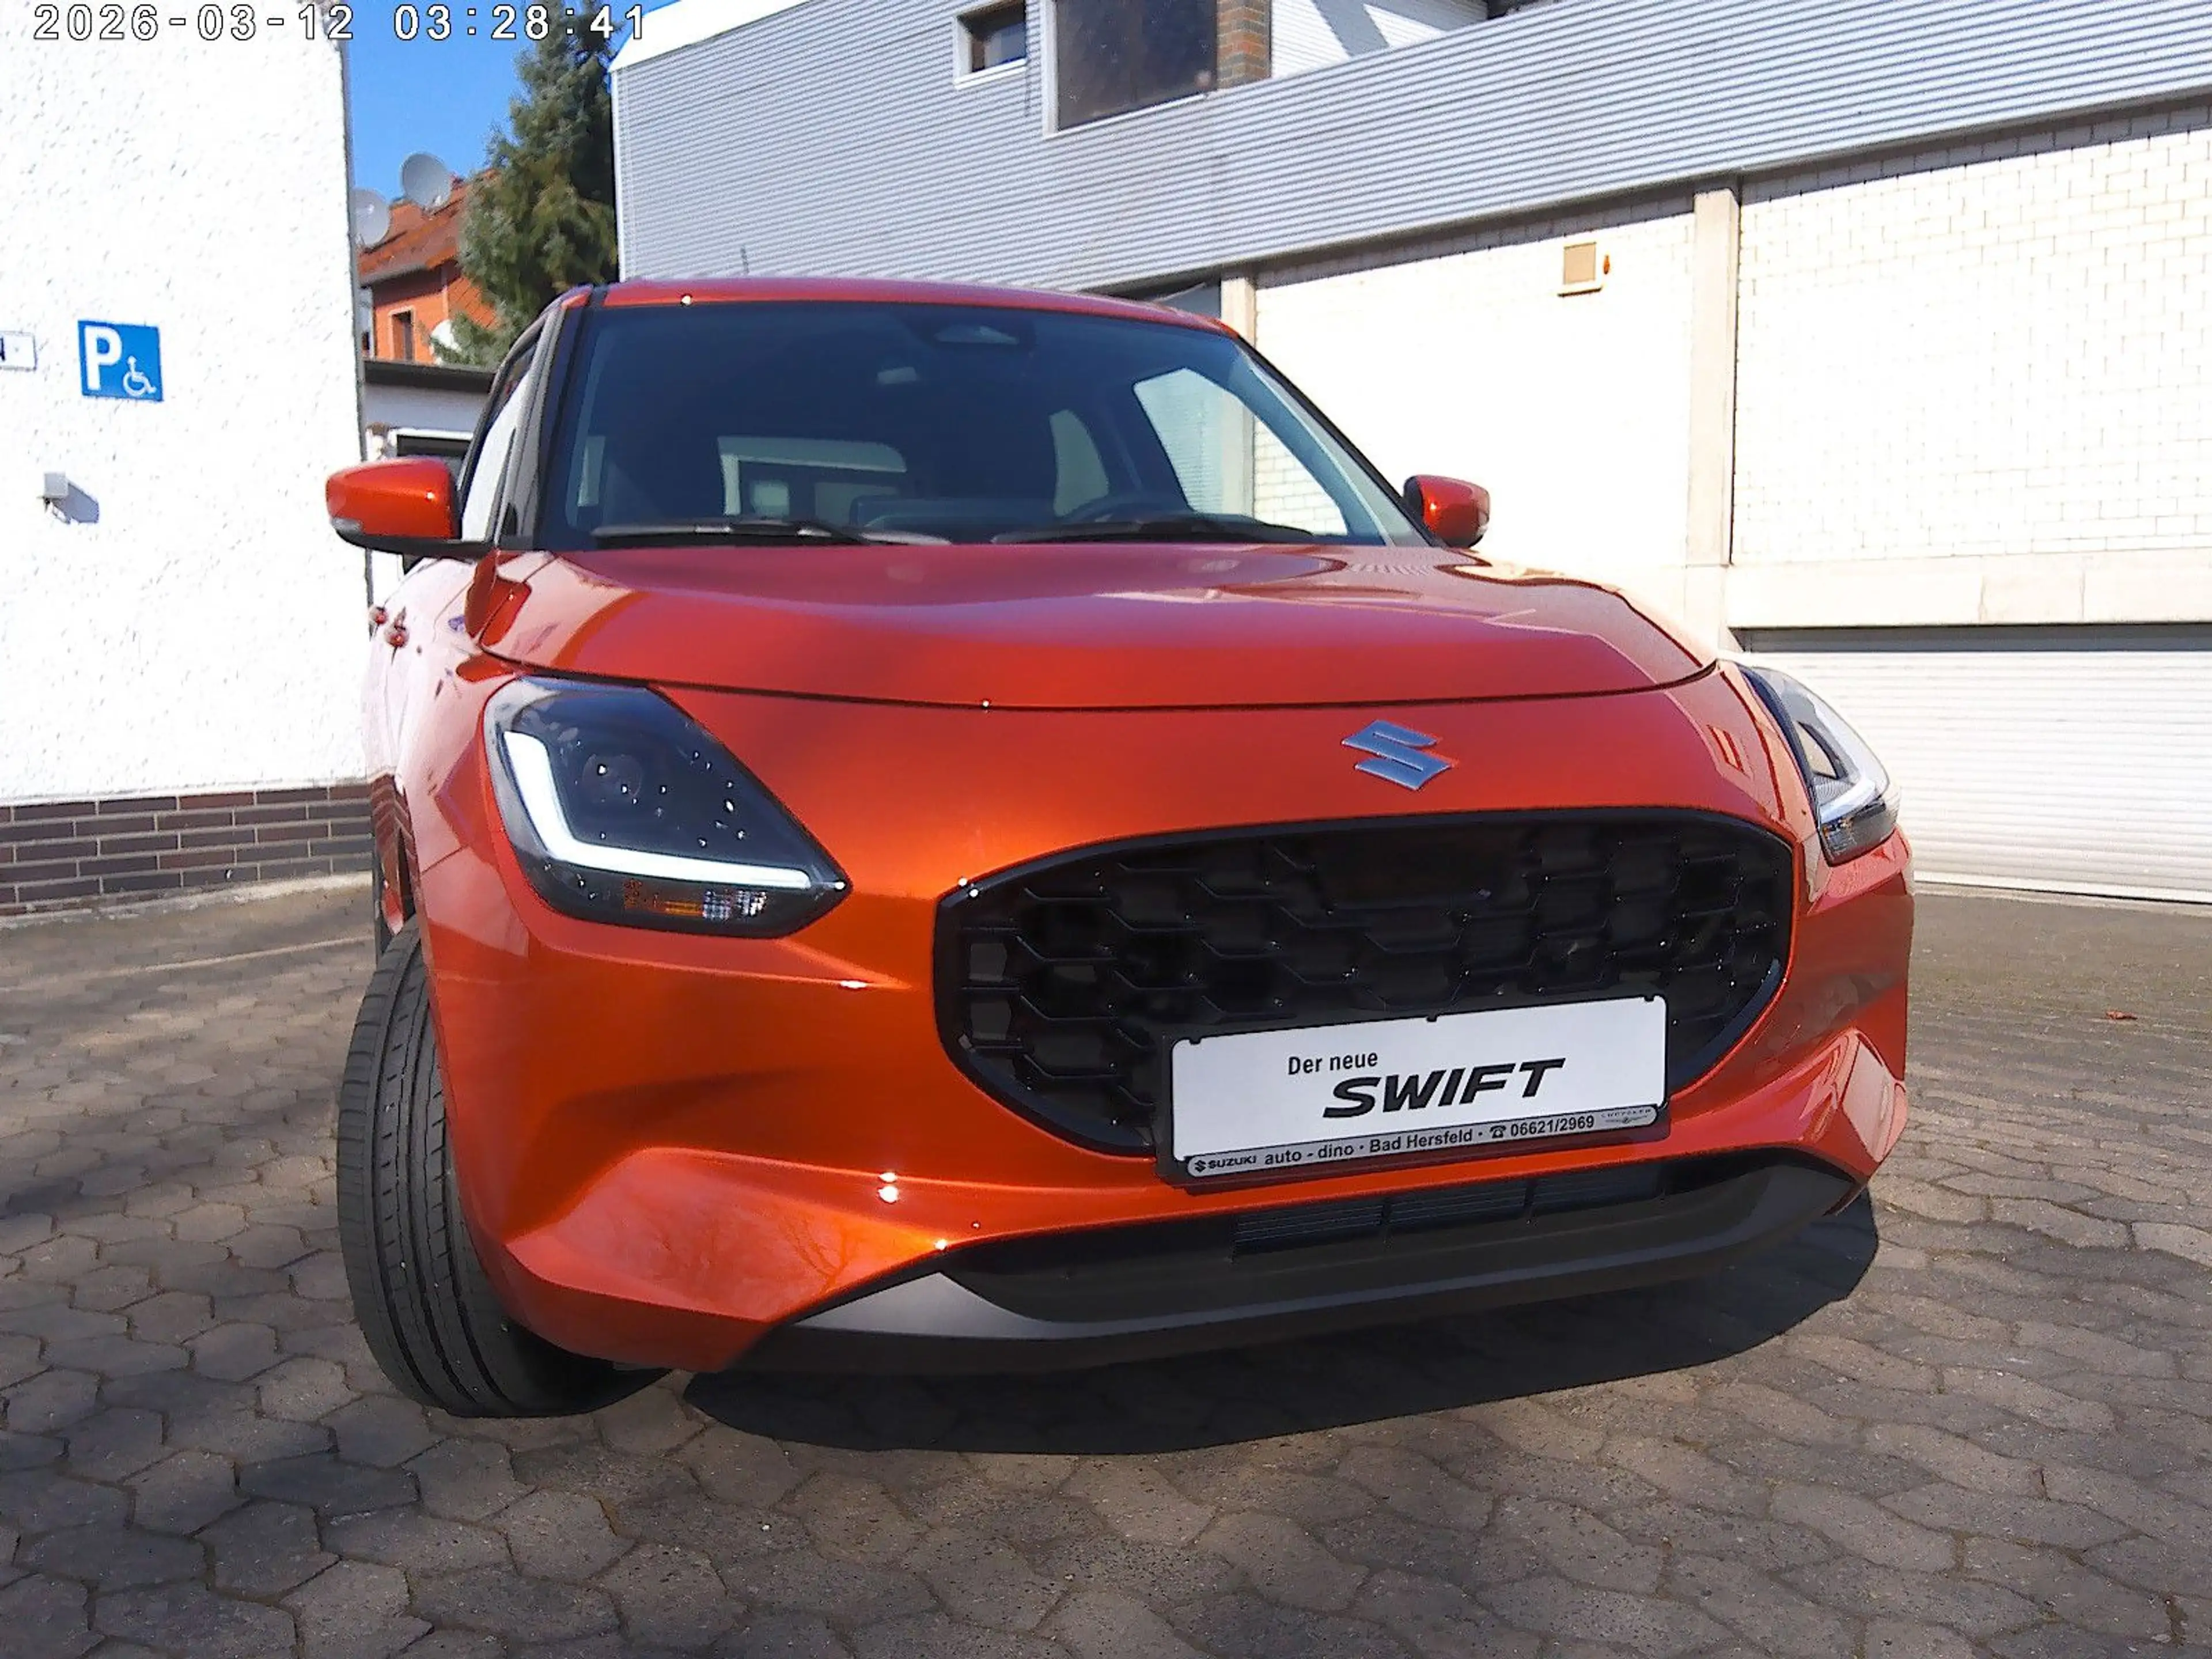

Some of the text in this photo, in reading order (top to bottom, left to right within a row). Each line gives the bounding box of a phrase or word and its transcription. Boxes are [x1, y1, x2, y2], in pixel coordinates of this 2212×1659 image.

[85, 325, 122, 391] P
[1287, 1051, 1378, 1075] Der neue
[1323, 1058, 1566, 1118] SWIFT
[1207, 1155, 1257, 1169] SUZUKI
[1264, 1150, 1302, 1165] auto
[1317, 1143, 1354, 1158] dino
[1369, 1136, 1402, 1153] Bad
[1406, 1128, 1473, 1148] Hersfeld
[1510, 1115, 1594, 1137] 06621/2969
